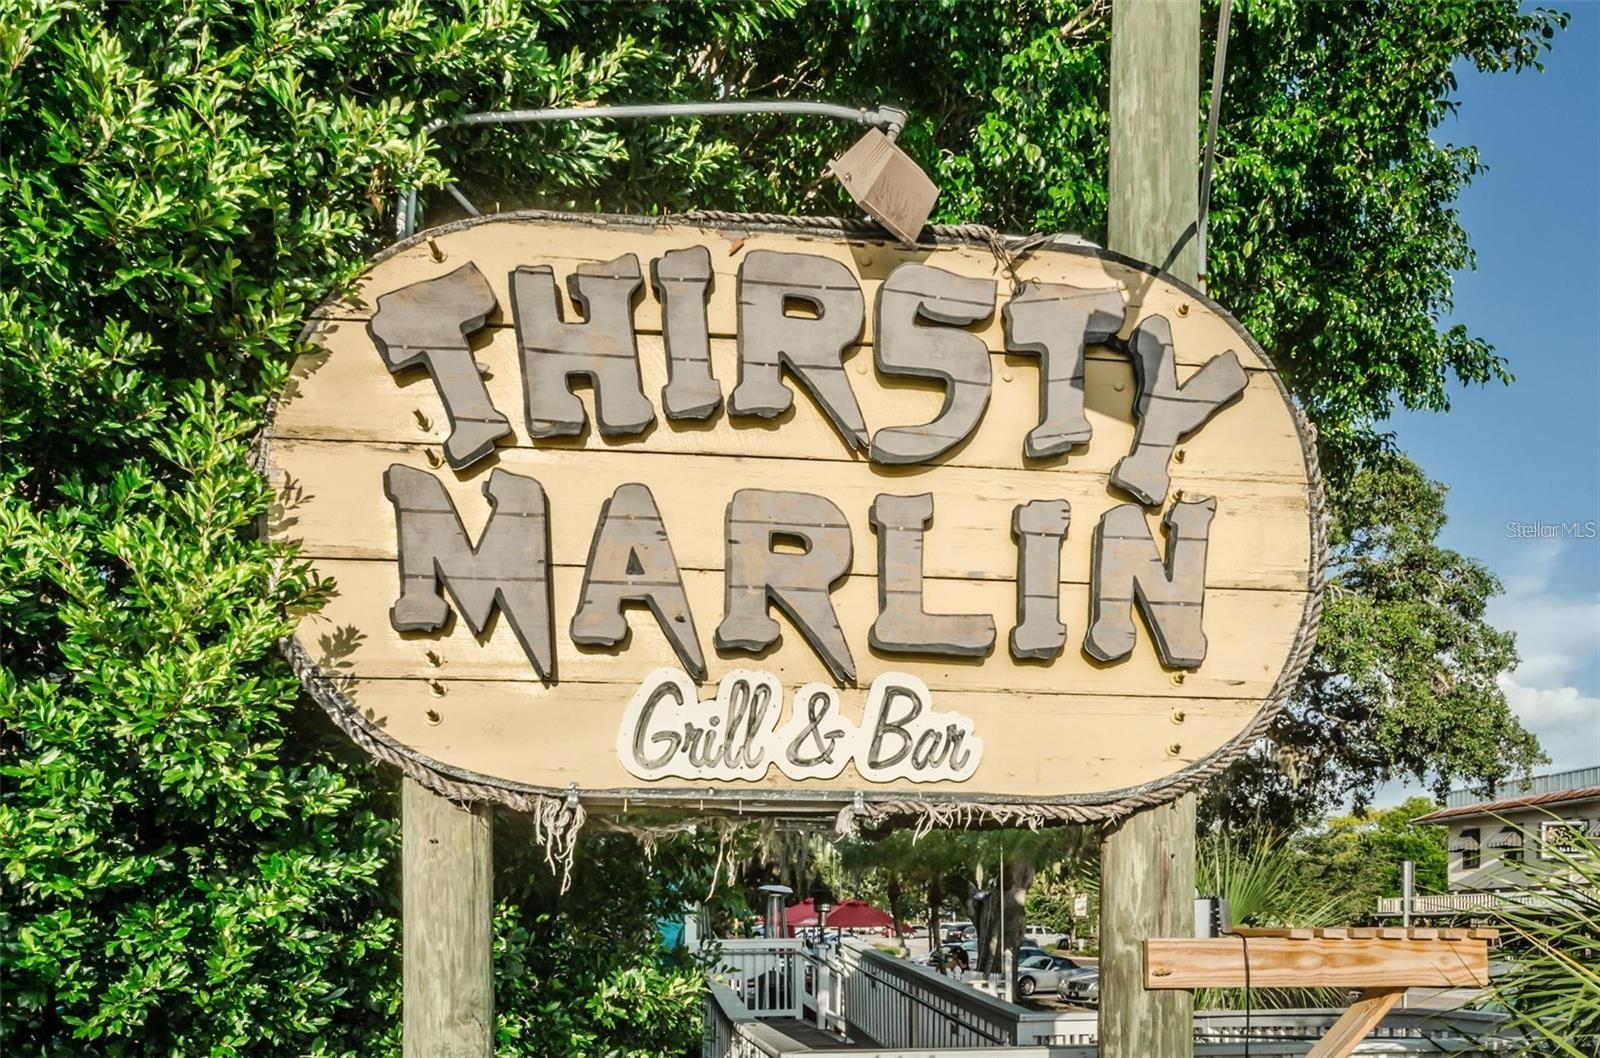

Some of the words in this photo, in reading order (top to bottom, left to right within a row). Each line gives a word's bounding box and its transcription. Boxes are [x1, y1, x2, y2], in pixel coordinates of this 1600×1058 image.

[366, 245, 1248, 505] THIRSTY
[384, 463, 1216, 682] MARLIN
[632, 679, 764, 769] Grill
[786, 691, 845, 767] &
[867, 685, 971, 771] Bar
